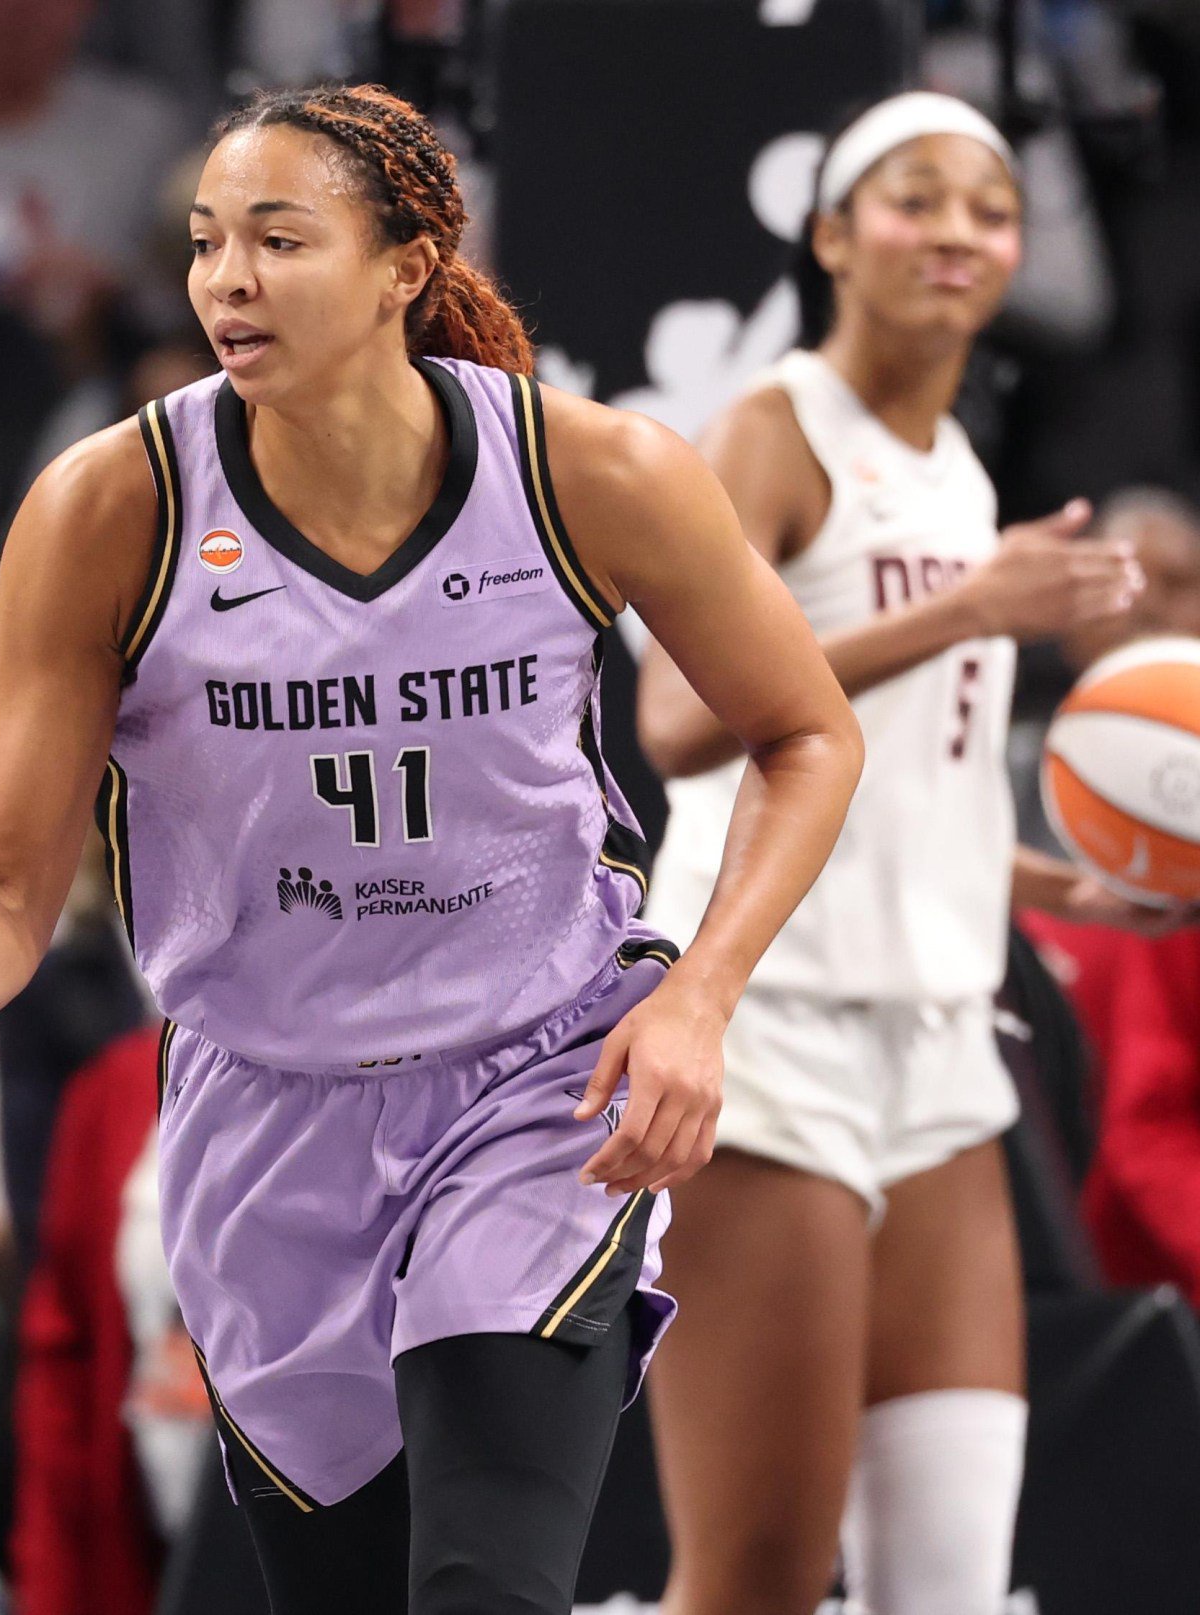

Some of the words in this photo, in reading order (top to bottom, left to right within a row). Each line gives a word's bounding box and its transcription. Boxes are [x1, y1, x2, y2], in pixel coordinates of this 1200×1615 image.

[478, 568, 544, 594] freedom
[205, 674, 378, 731] GOLDEN
[399, 653, 538, 722] STATE
[309, 746, 433, 848] 41
[355, 878, 425, 900] KAISER
[356, 881, 494, 921] PERMANENTE
